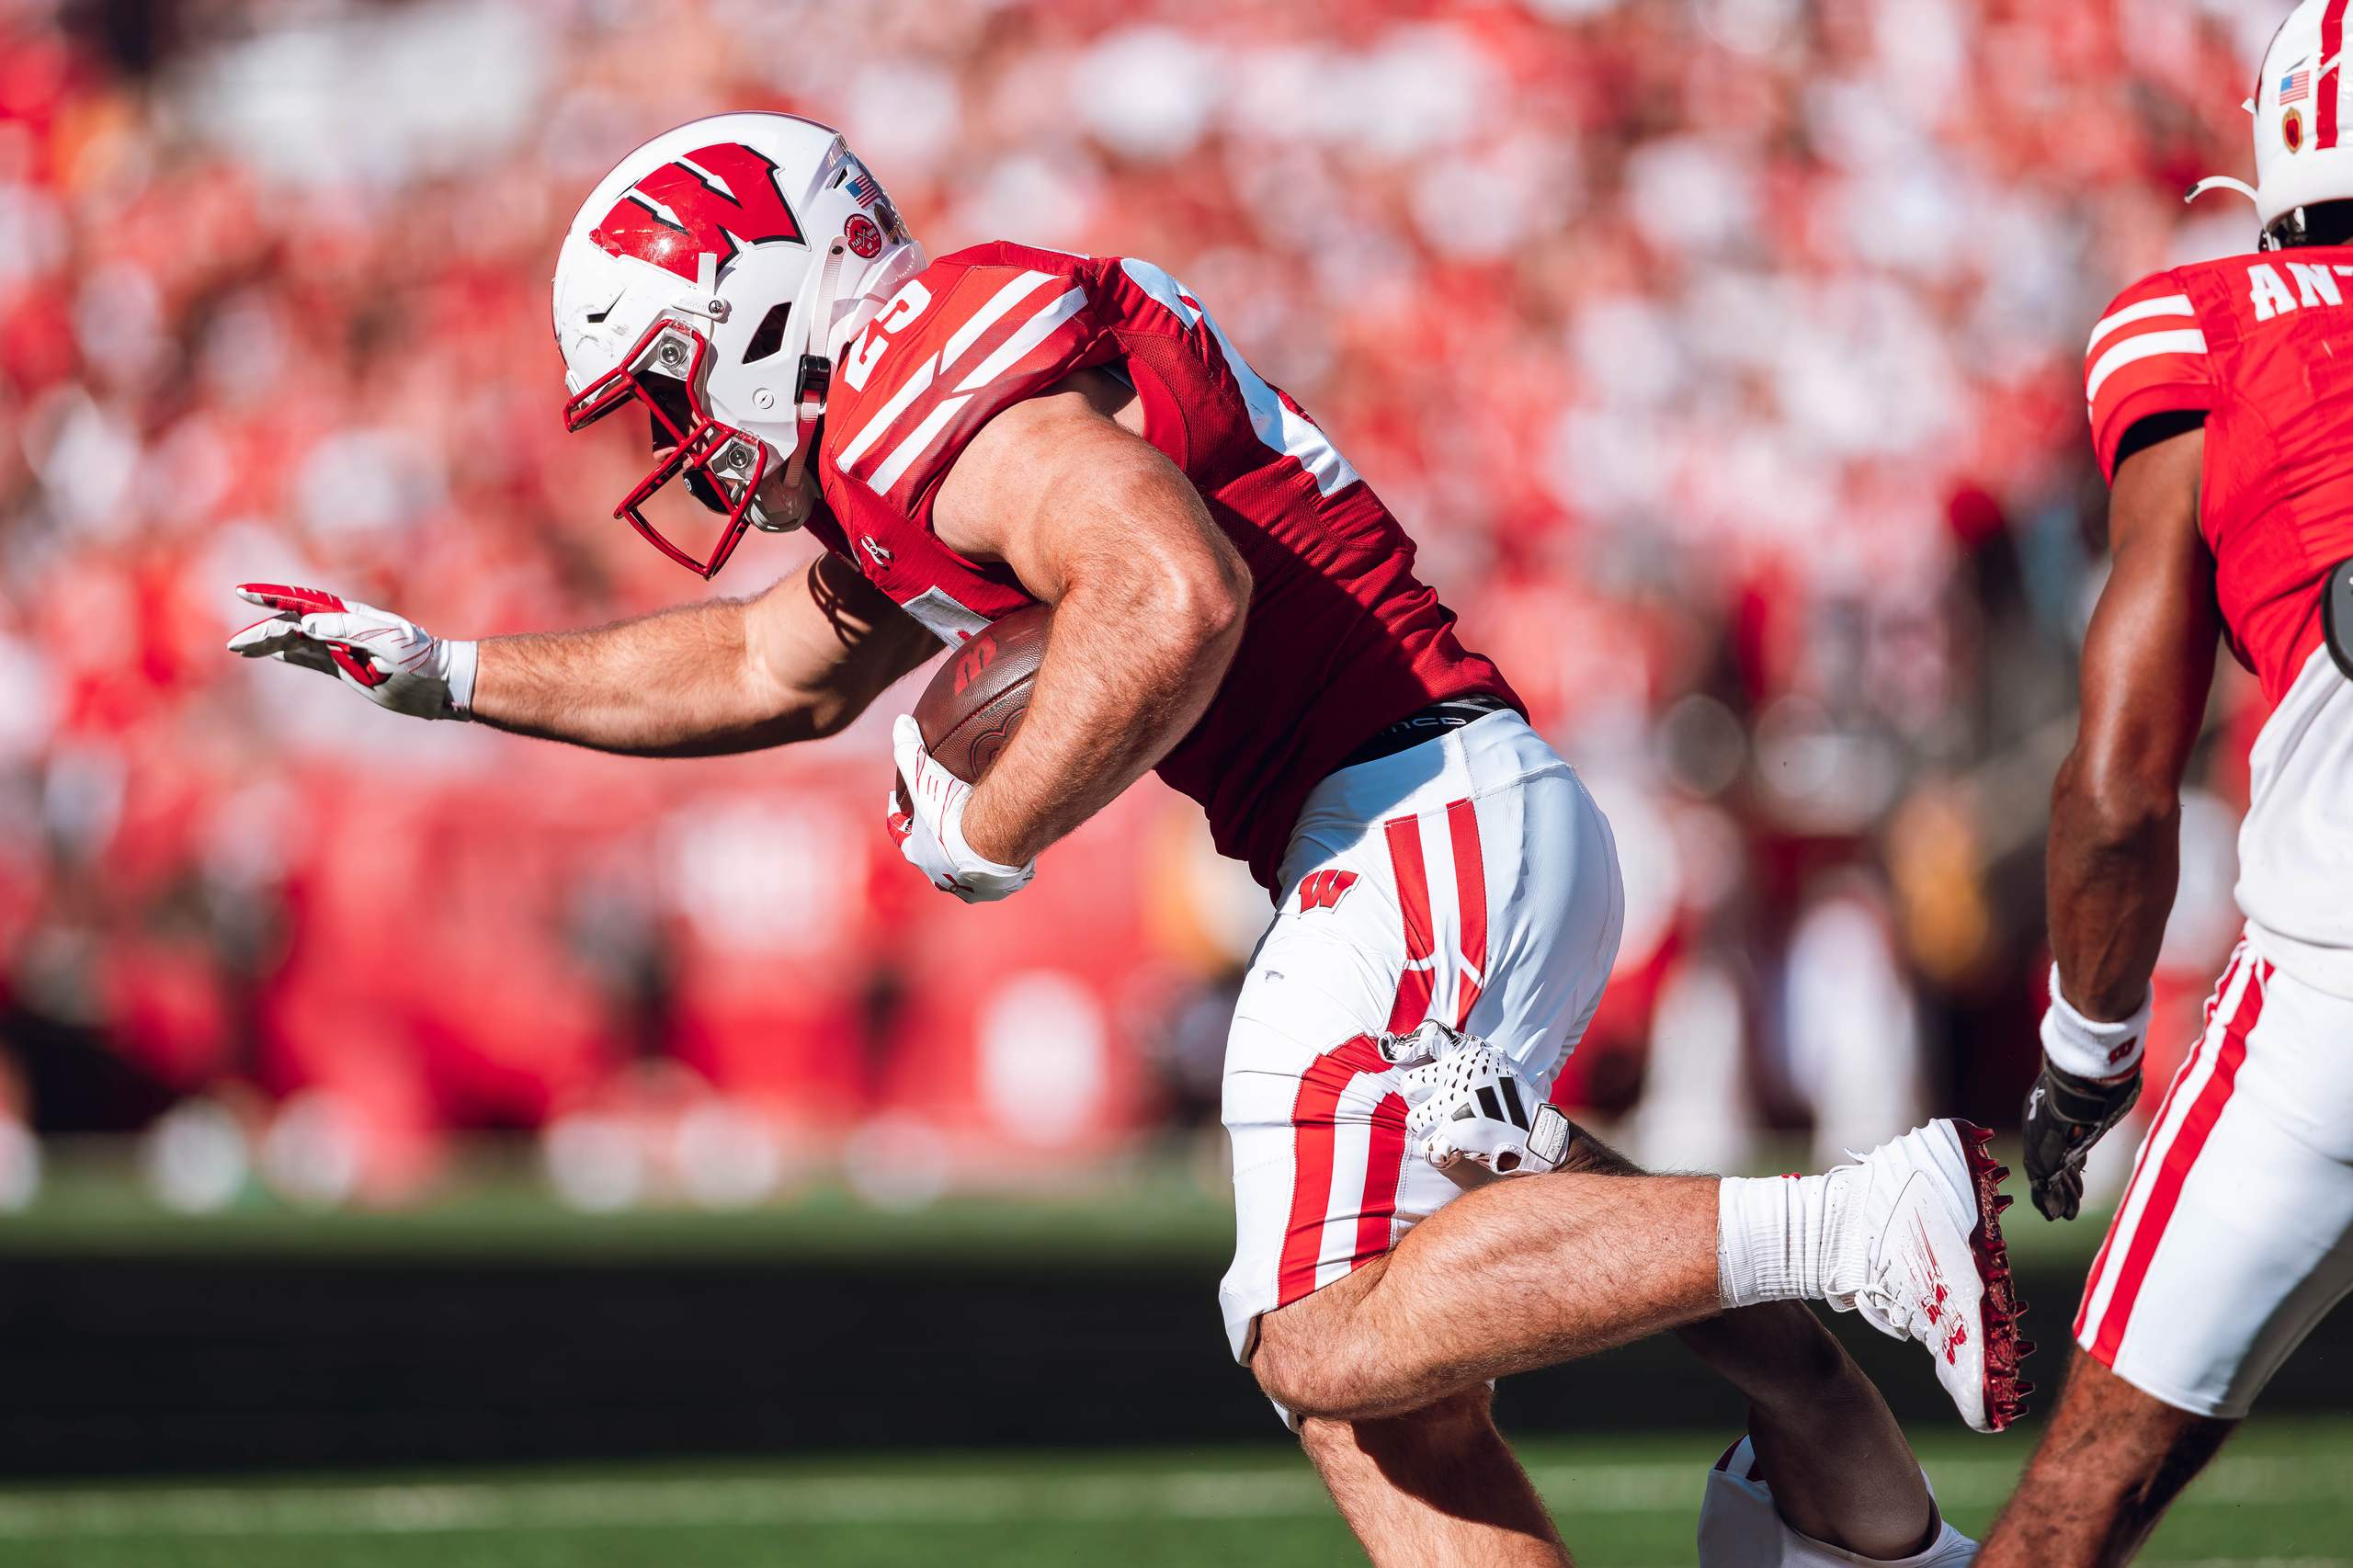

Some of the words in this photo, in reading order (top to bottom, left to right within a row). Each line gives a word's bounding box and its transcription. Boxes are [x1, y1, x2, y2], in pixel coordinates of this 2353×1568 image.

[589, 142, 807, 283] W
[845, 278, 934, 392] 25
[1298, 869, 1358, 915] W
